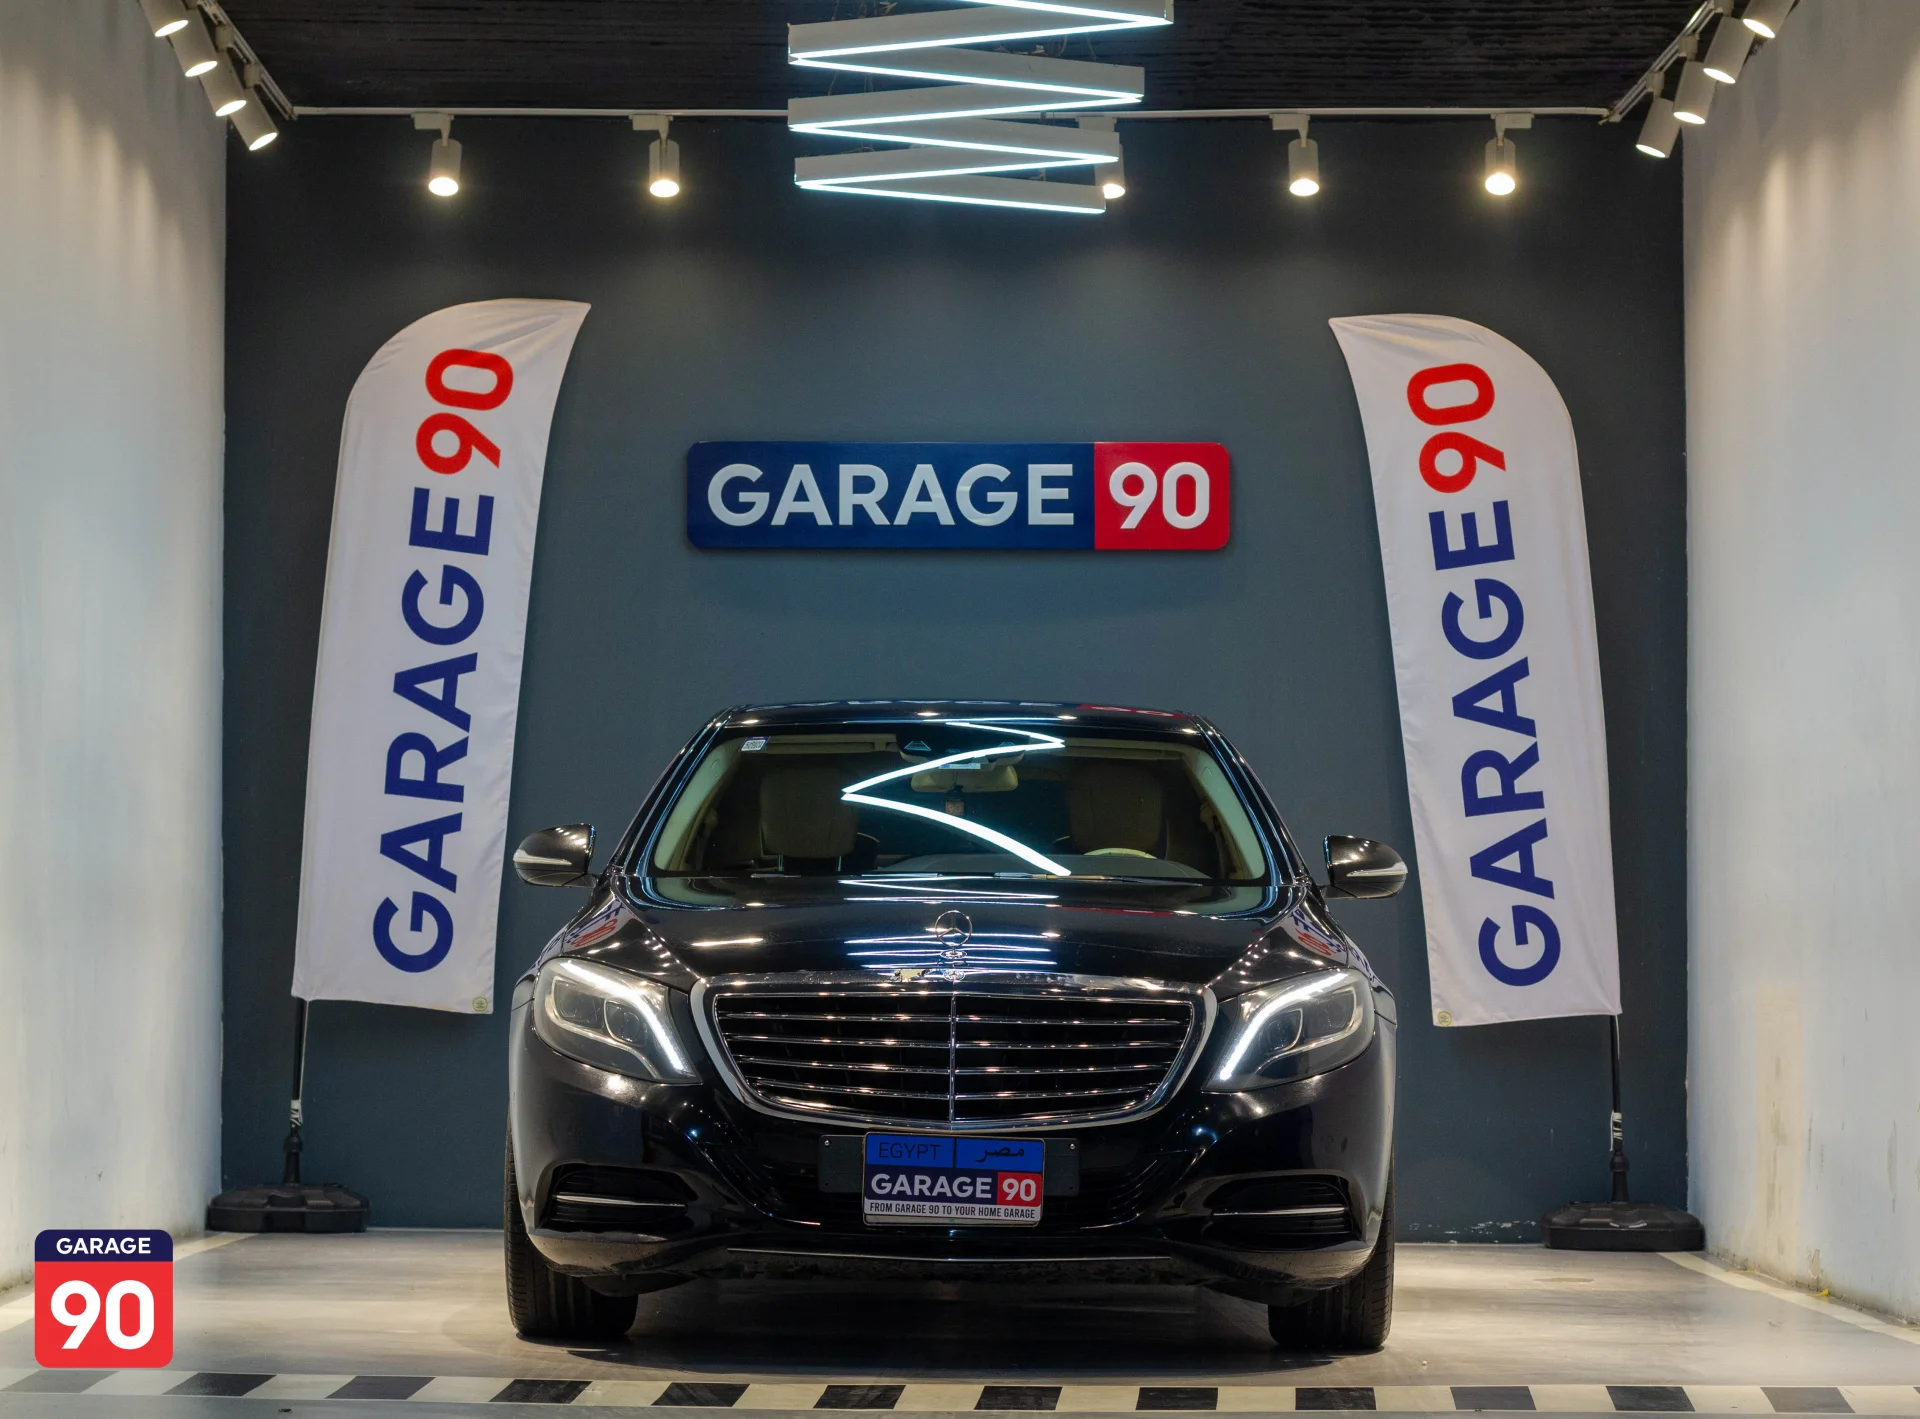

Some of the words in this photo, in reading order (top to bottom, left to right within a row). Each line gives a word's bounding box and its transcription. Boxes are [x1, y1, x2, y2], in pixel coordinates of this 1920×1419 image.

[707, 463, 1074, 527] GARAGE
[1108, 461, 1211, 530] 90
[877, 1142, 941, 1160] EGYPT
[975, 1146, 1025, 1163] مصر
[870, 1173, 992, 1199] GARAGE
[1002, 1178, 1037, 1202] 90
[869, 1202, 893, 1213] FROM
[895, 1204, 926, 1215] GARAGE
[928, 1206, 941, 1215] 90
[942, 1206, 952, 1215] TO
[955, 1207, 976, 1216] YOUR
[978, 1208, 1002, 1217] HOME
[1003, 1209, 1036, 1219] GARAGE
